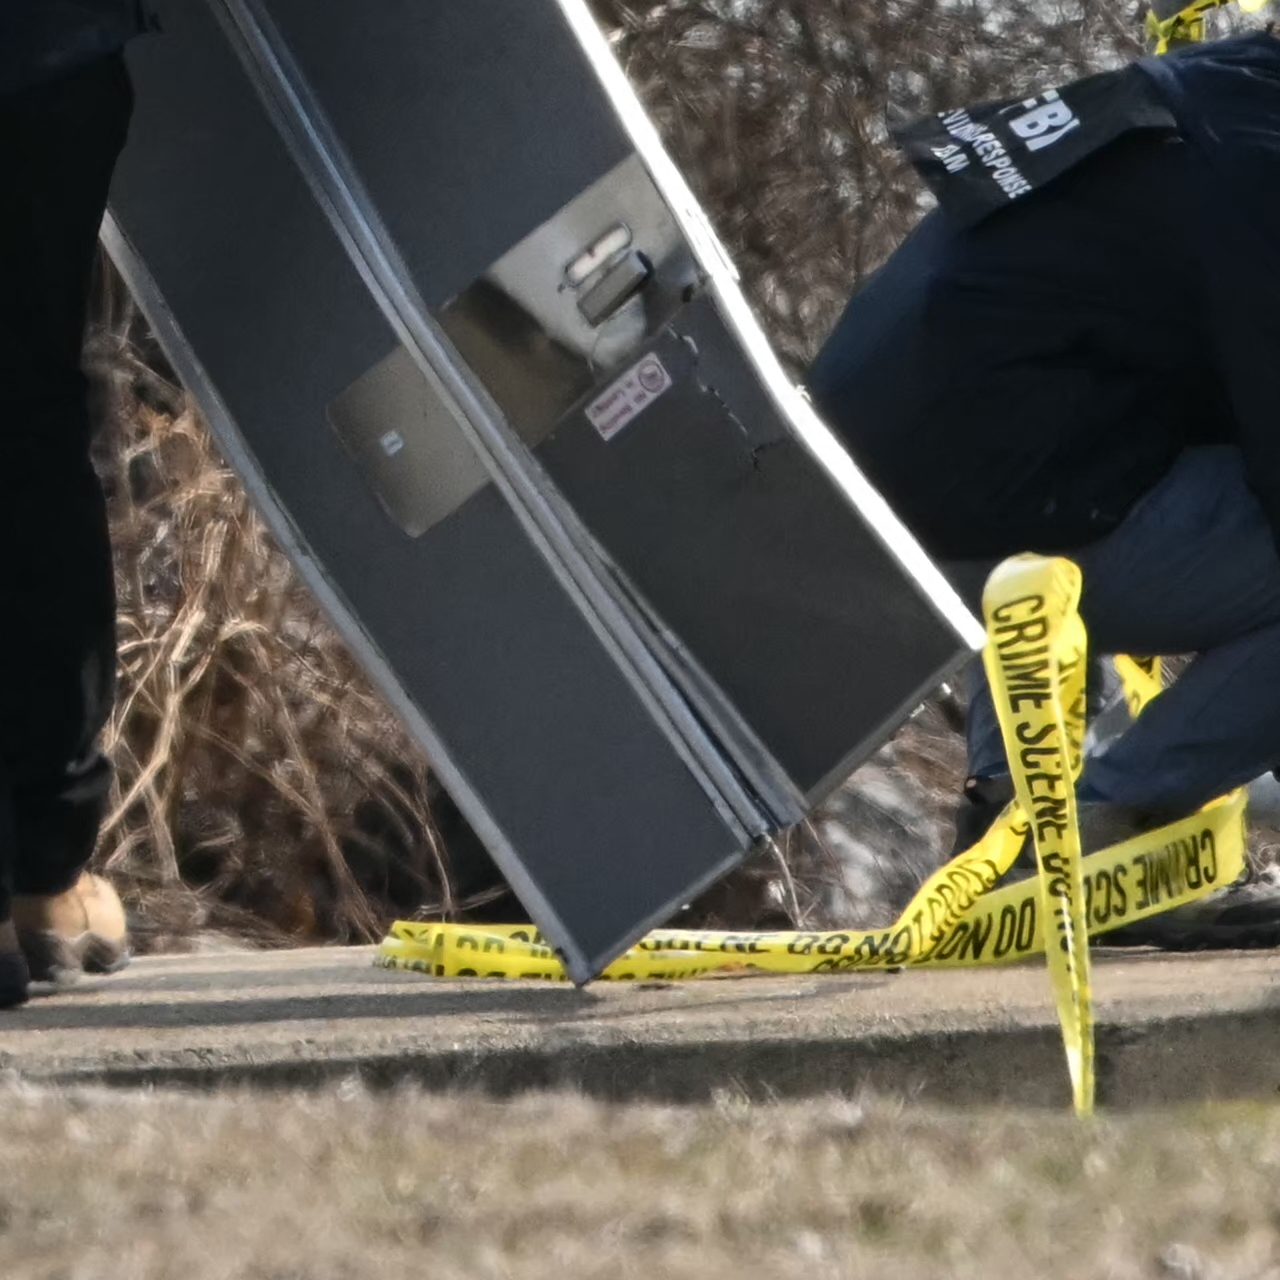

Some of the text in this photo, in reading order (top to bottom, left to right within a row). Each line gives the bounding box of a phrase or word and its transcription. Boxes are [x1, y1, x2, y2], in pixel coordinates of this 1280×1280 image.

[930, 144, 970, 174] AM
[972, 132, 1033, 199] RESPONSE
[992, 594, 1053, 714] CRIME
[1015, 721, 1069, 843] SCENE
[1131, 828, 1218, 911] CRIME
[993, 896, 1036, 959] DO
